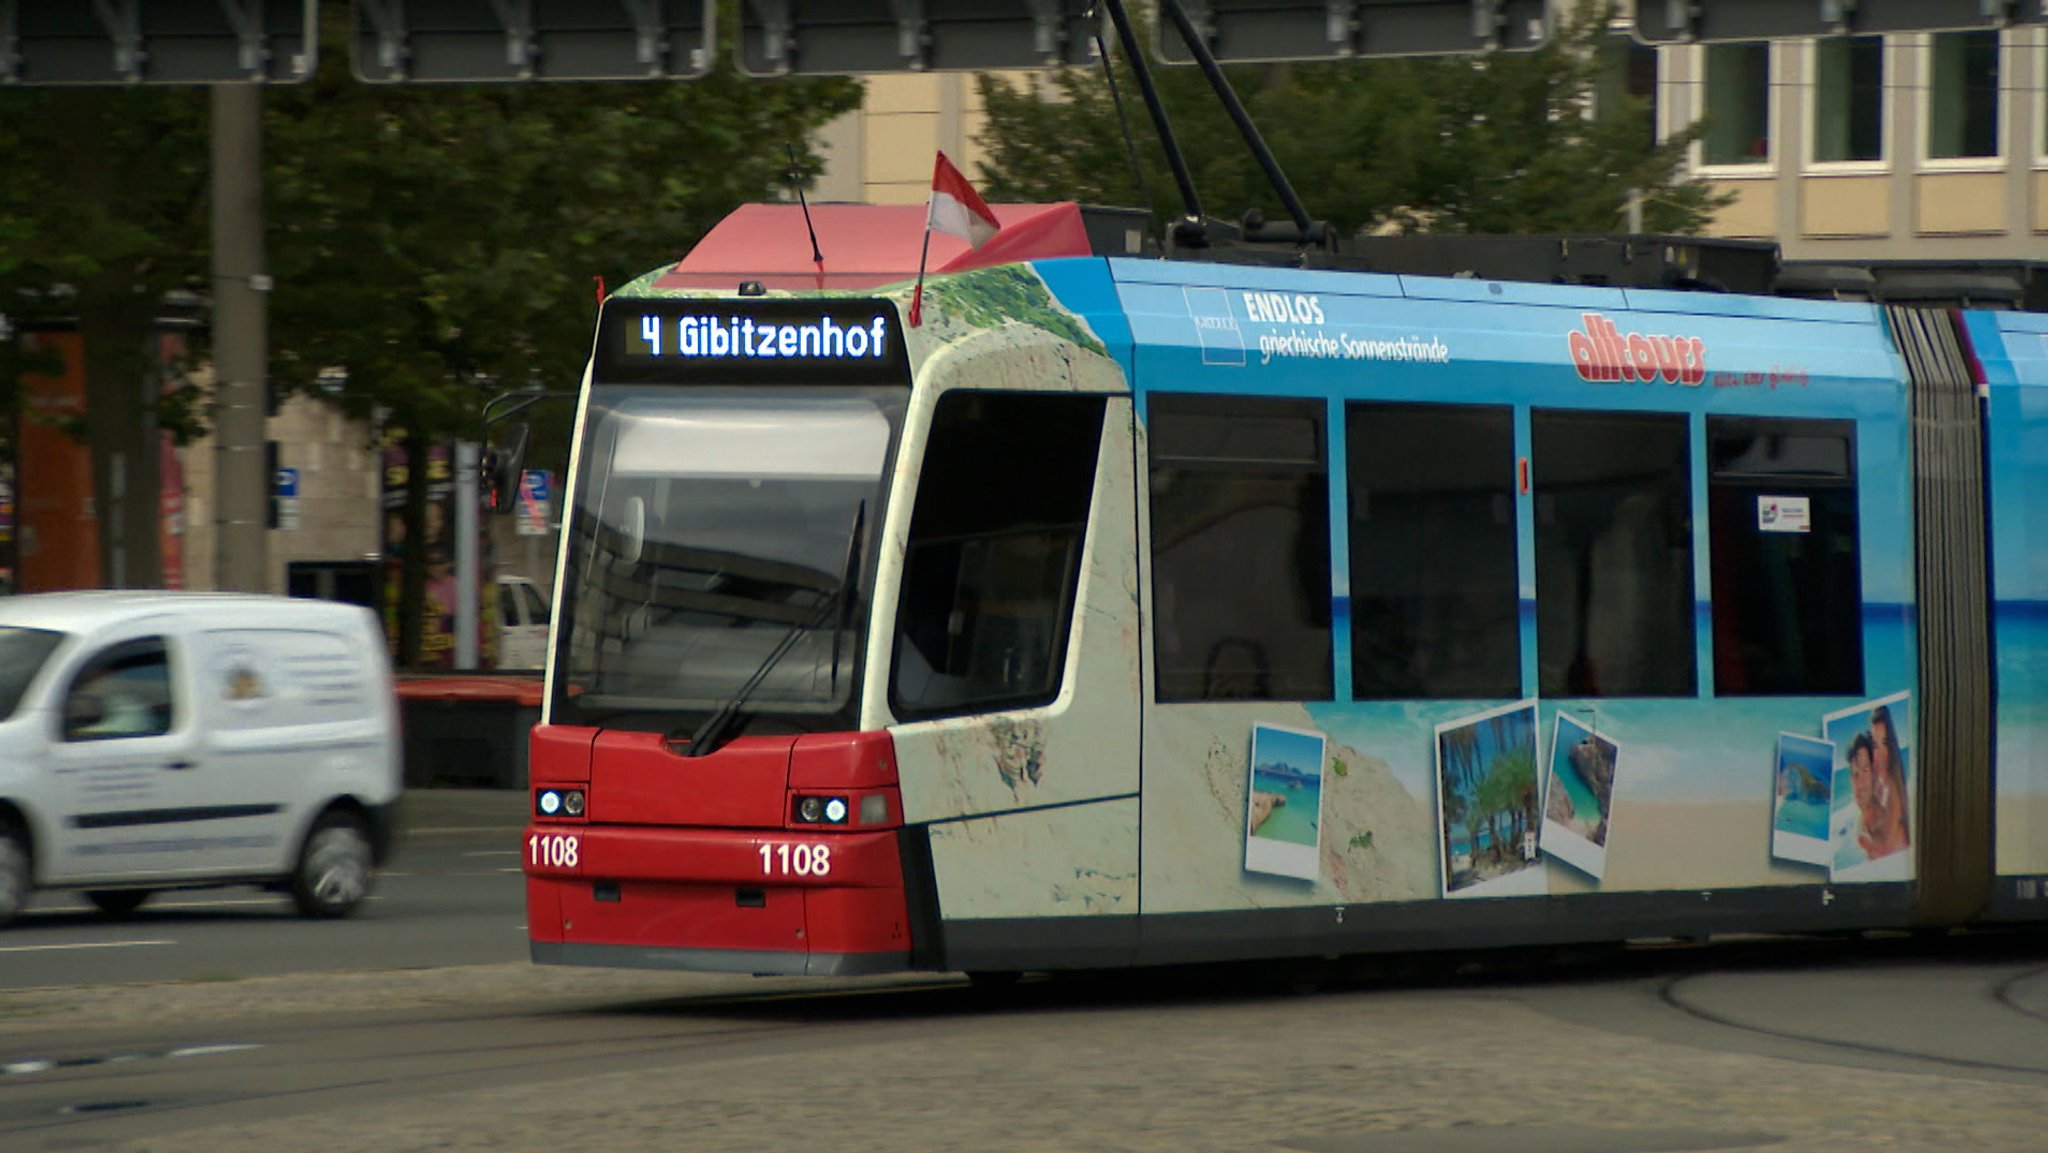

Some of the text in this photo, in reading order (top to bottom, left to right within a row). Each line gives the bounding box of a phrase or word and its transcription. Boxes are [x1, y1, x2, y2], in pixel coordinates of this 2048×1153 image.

[1243, 292, 1325, 325] ENDLOS
[641, 315, 887, 357] 4 Gibitzenhof
[1260, 328, 1450, 365] griechische Sonnenstrände
[1567, 312, 1707, 387] alltours
[528, 834, 580, 868] 1108
[758, 843, 831, 877] 1108
